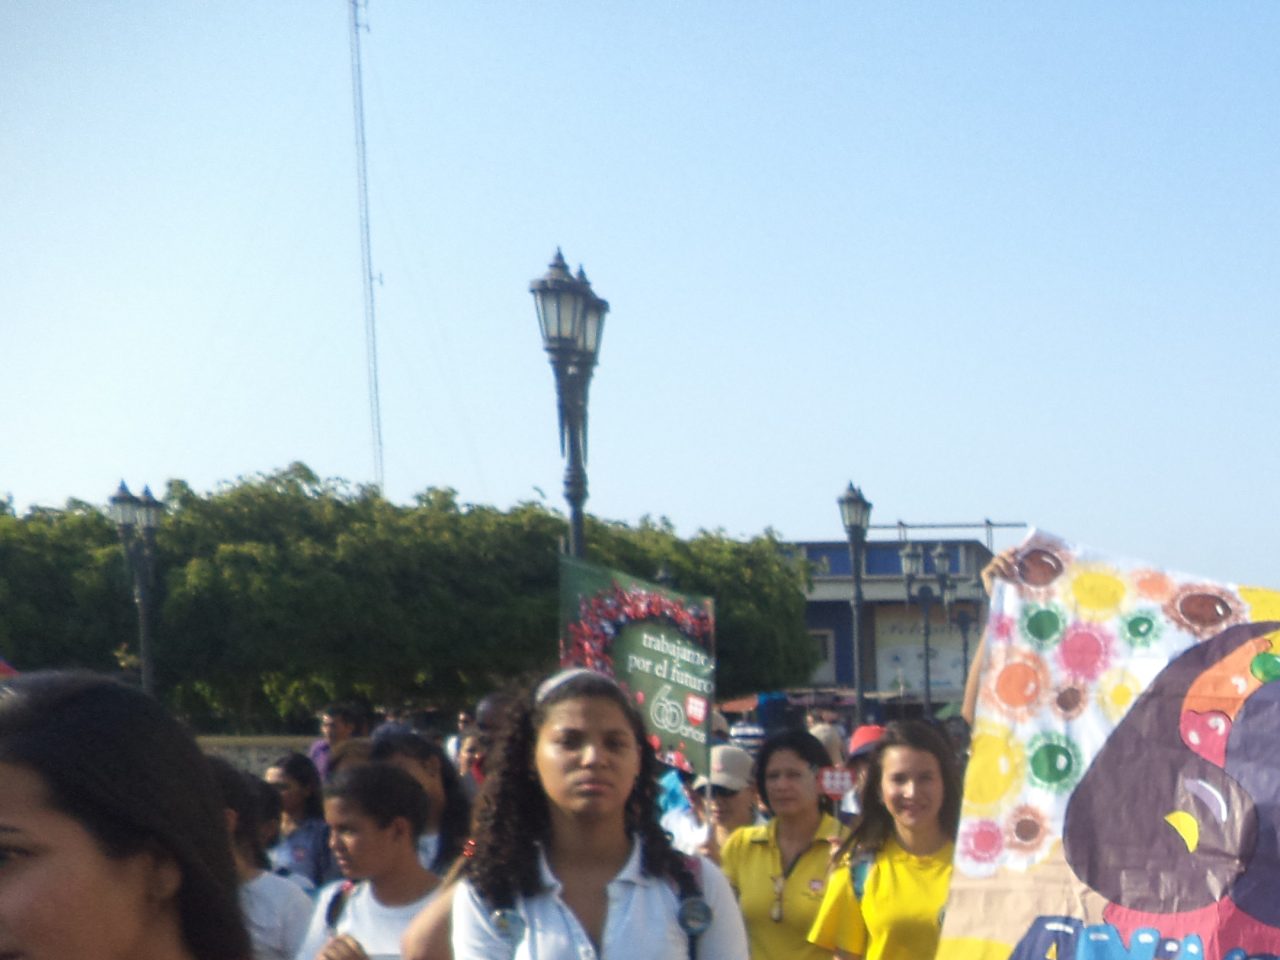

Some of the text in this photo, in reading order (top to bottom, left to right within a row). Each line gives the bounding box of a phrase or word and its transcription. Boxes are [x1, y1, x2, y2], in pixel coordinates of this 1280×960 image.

[628, 655, 714, 693] por el futuro
[650, 684, 684, 733] 60
